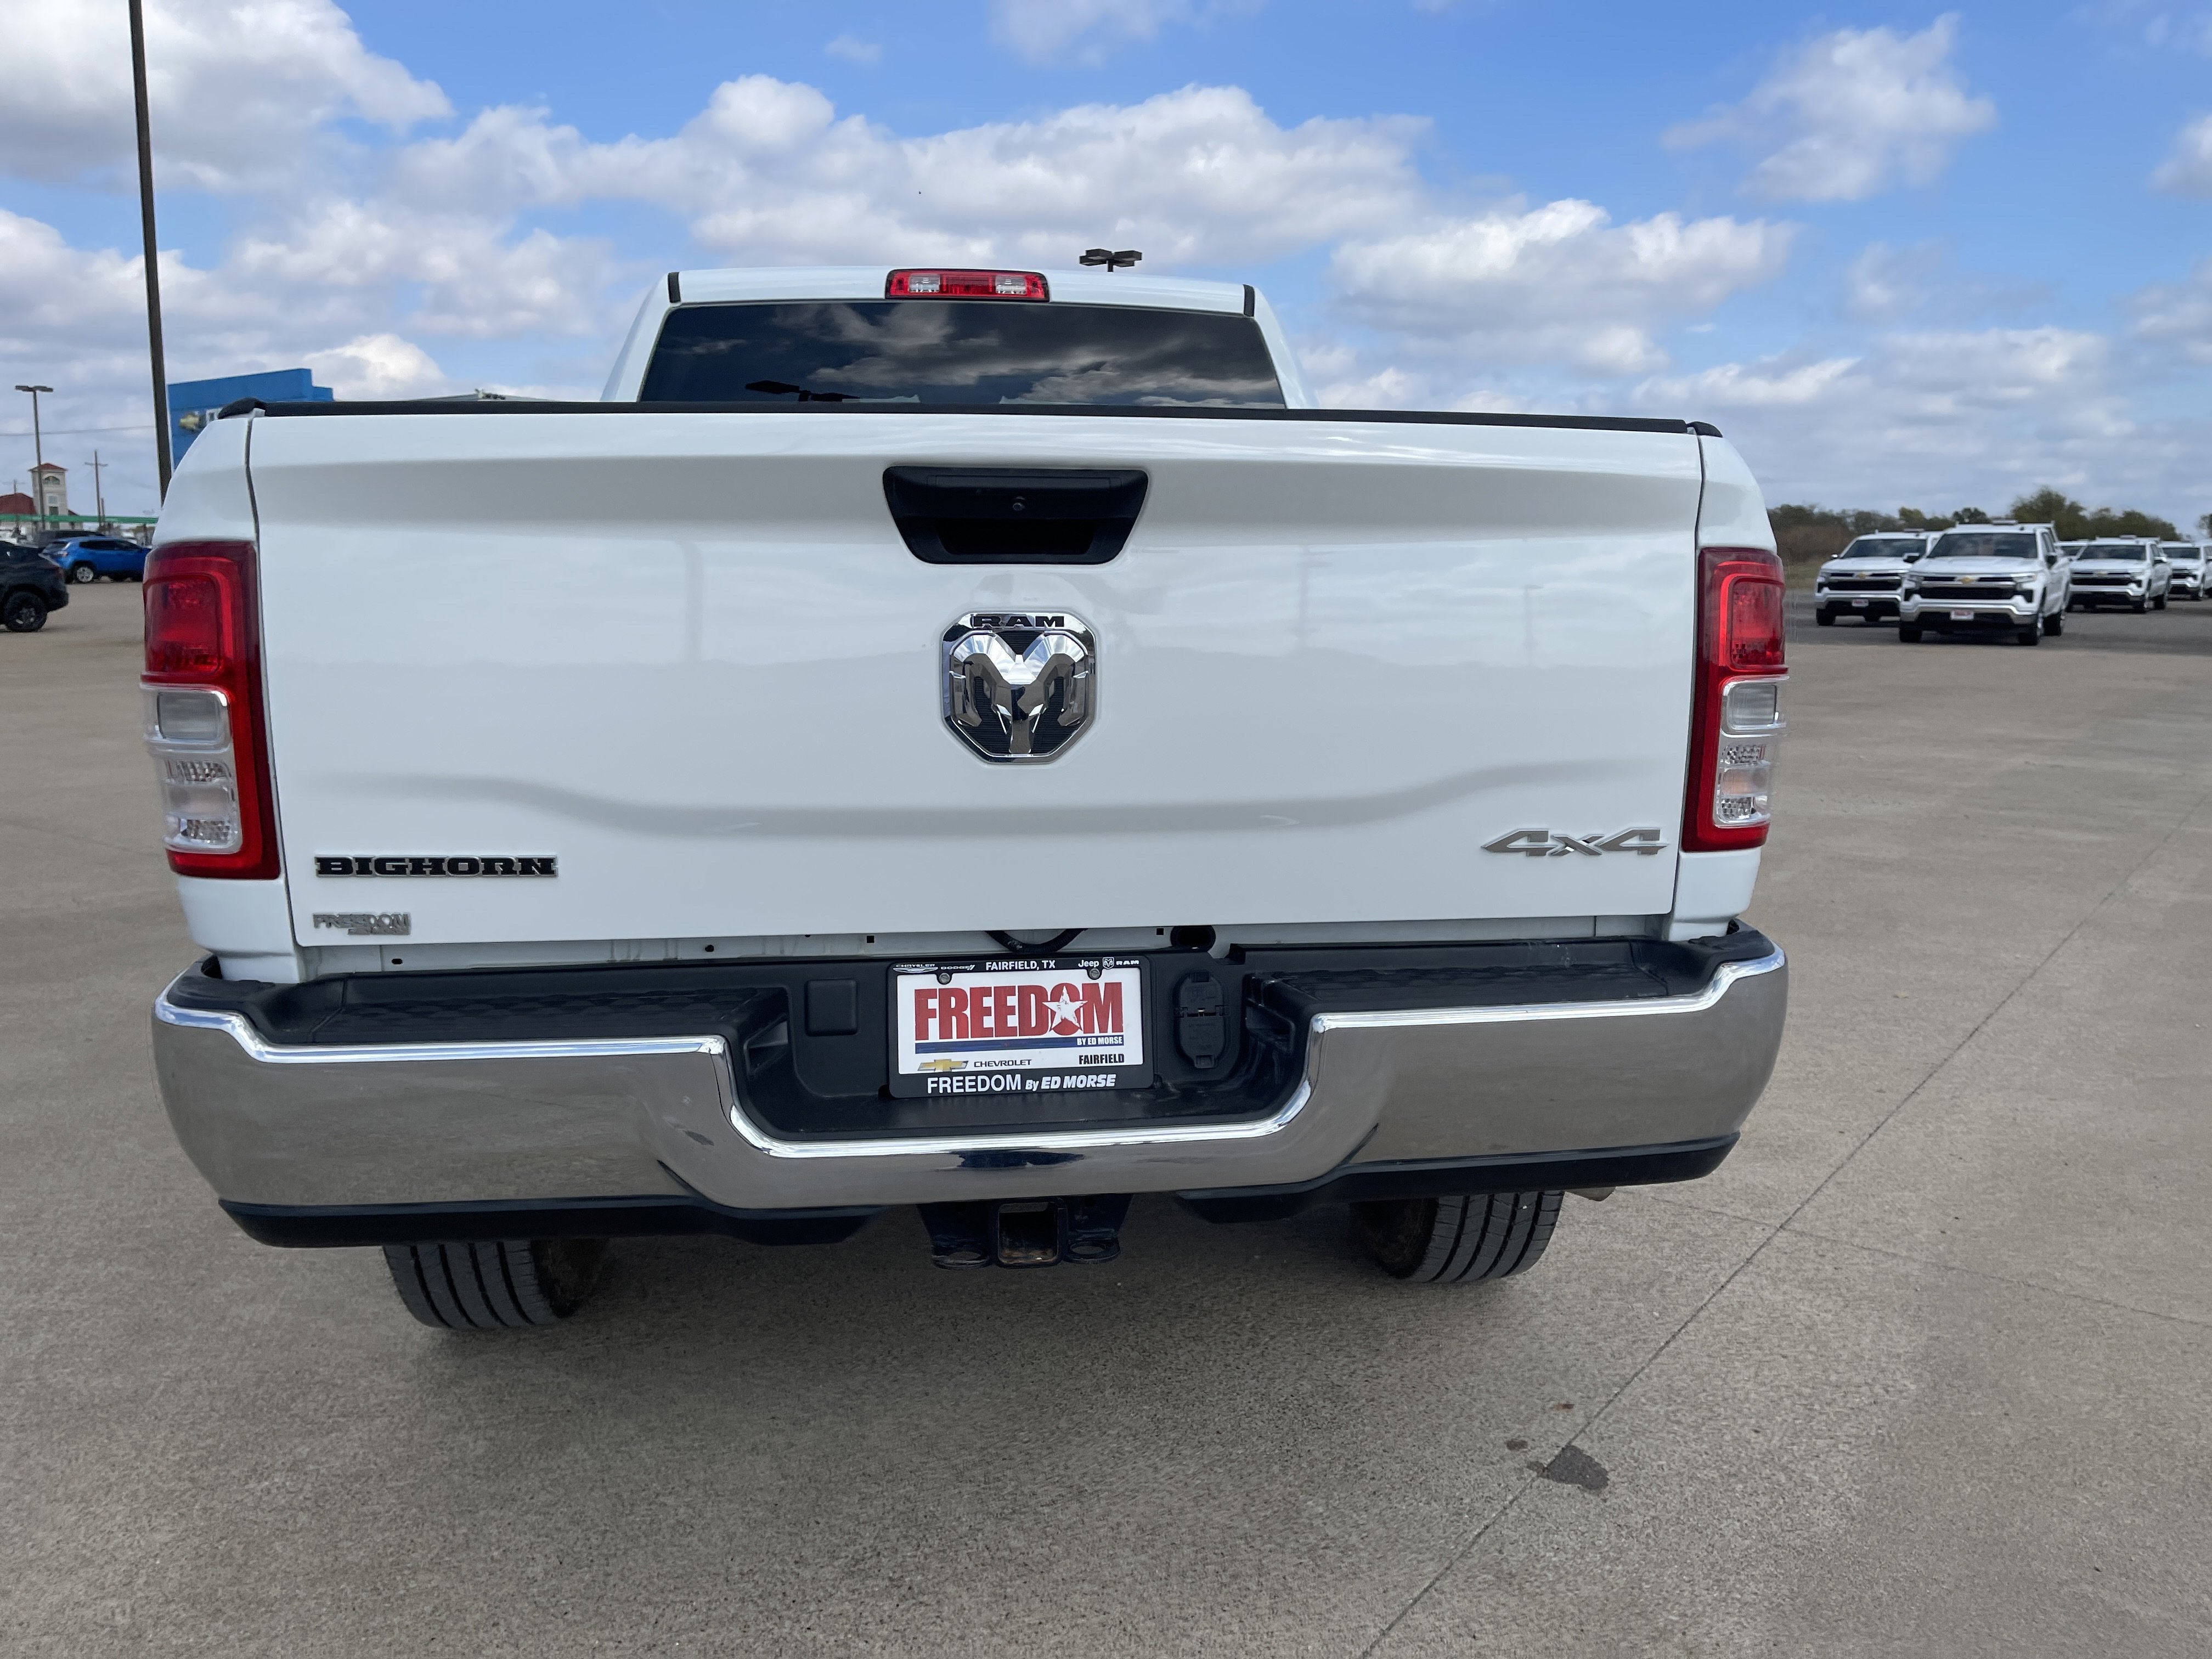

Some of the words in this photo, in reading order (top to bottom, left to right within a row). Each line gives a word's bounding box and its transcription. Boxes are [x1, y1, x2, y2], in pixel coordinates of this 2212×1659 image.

[972, 615, 1065, 628] RAM
[314, 855, 558, 878] BIGHORN
[986, 961, 1040, 971] FAIRFIELD,
[1042, 960, 1056, 969] TX
[1078, 960, 1099, 968] Jeep
[914, 981, 1124, 1040] FREEDOM
[1076, 1037, 1086, 1046] BY
[1087, 1037, 1097, 1045] ED
[1097, 1036, 1122, 1045] MORSE
[974, 1059, 1032, 1068] CHEVROLET
[1079, 1053, 1125, 1065] FAIRFIELD
[927, 1074, 1021, 1093] FREEDOM
[1025, 1079, 1039, 1091] By
[1041, 1076, 1062, 1090] ED
[1063, 1074, 1116, 1089] MORSE
